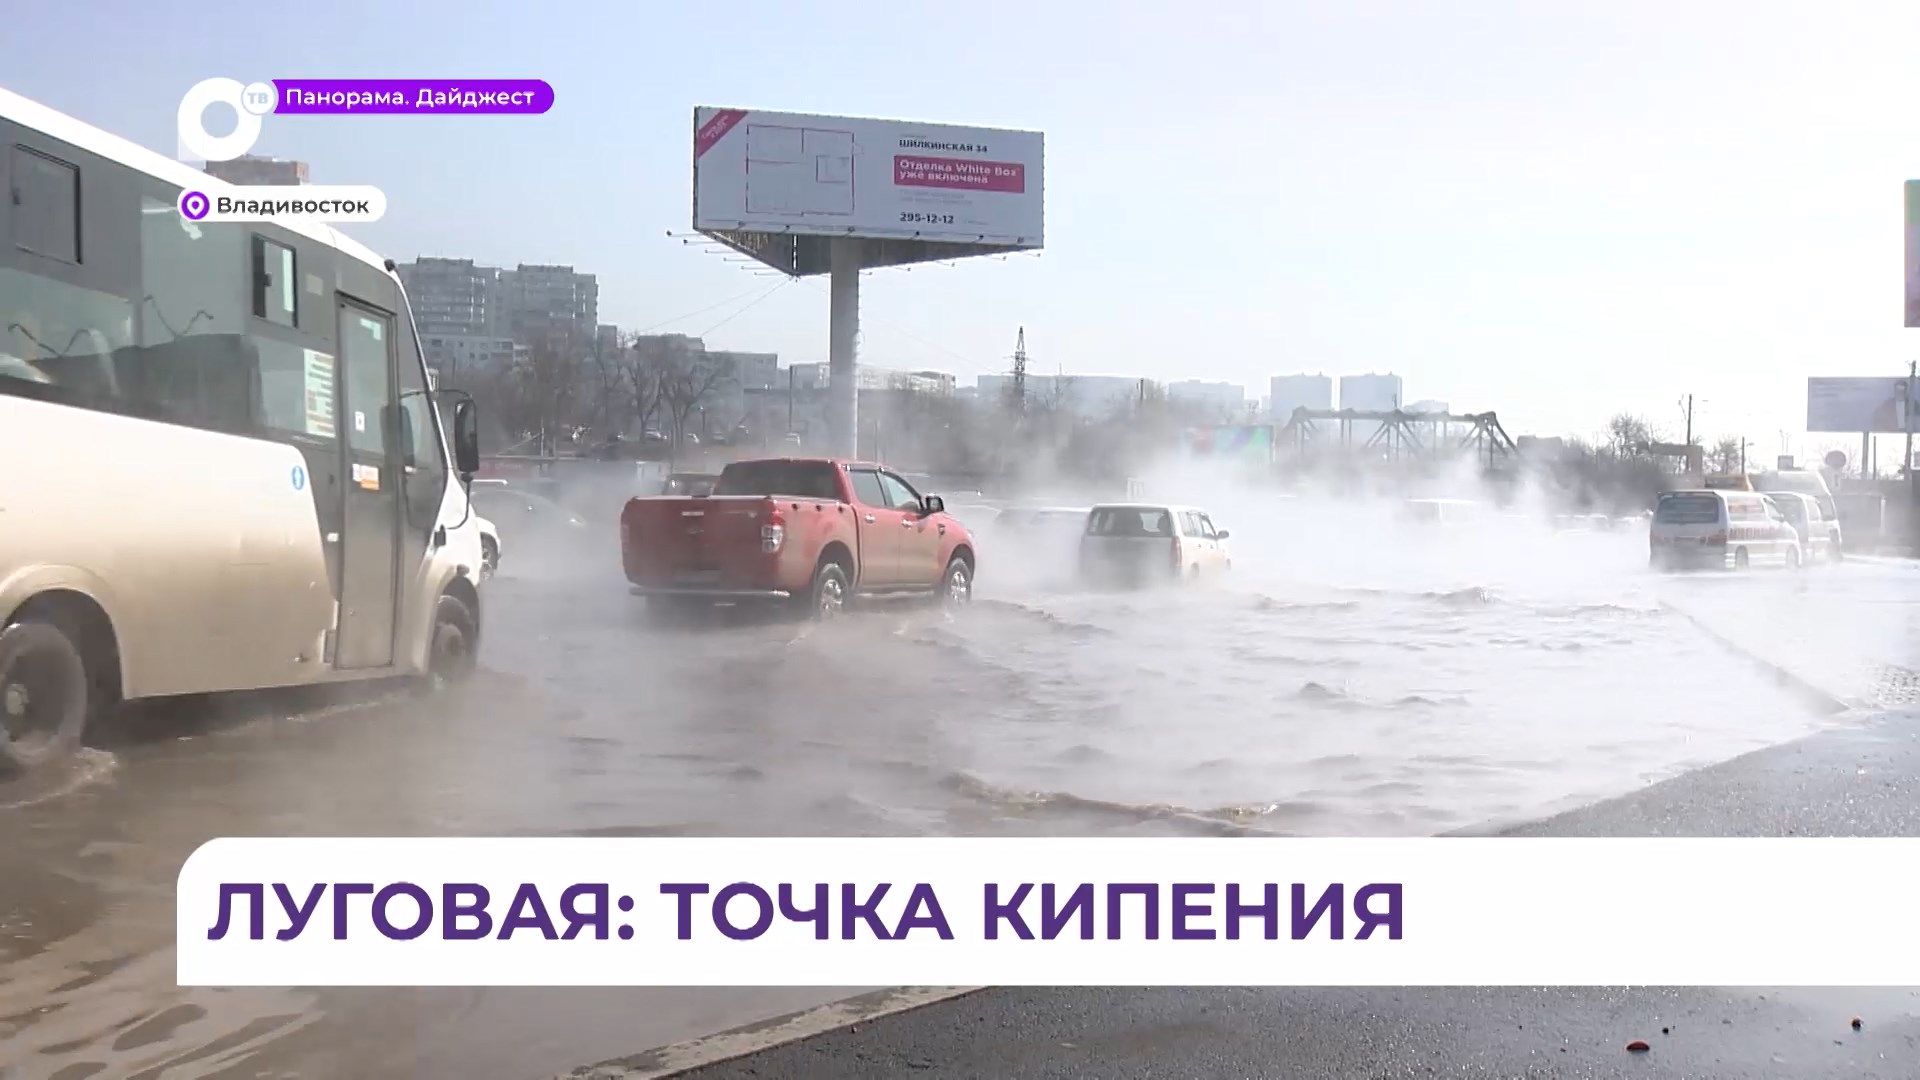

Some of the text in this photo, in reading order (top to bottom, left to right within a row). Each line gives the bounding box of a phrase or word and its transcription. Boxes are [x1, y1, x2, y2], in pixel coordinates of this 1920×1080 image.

[899, 139, 973, 152] ШИЛКИНСКАЯ
[899, 159, 952, 173] Отделка
[956, 163, 991, 175] White
[899, 170, 988, 184] уже включена
[899, 211, 955, 225] 295-12-12
